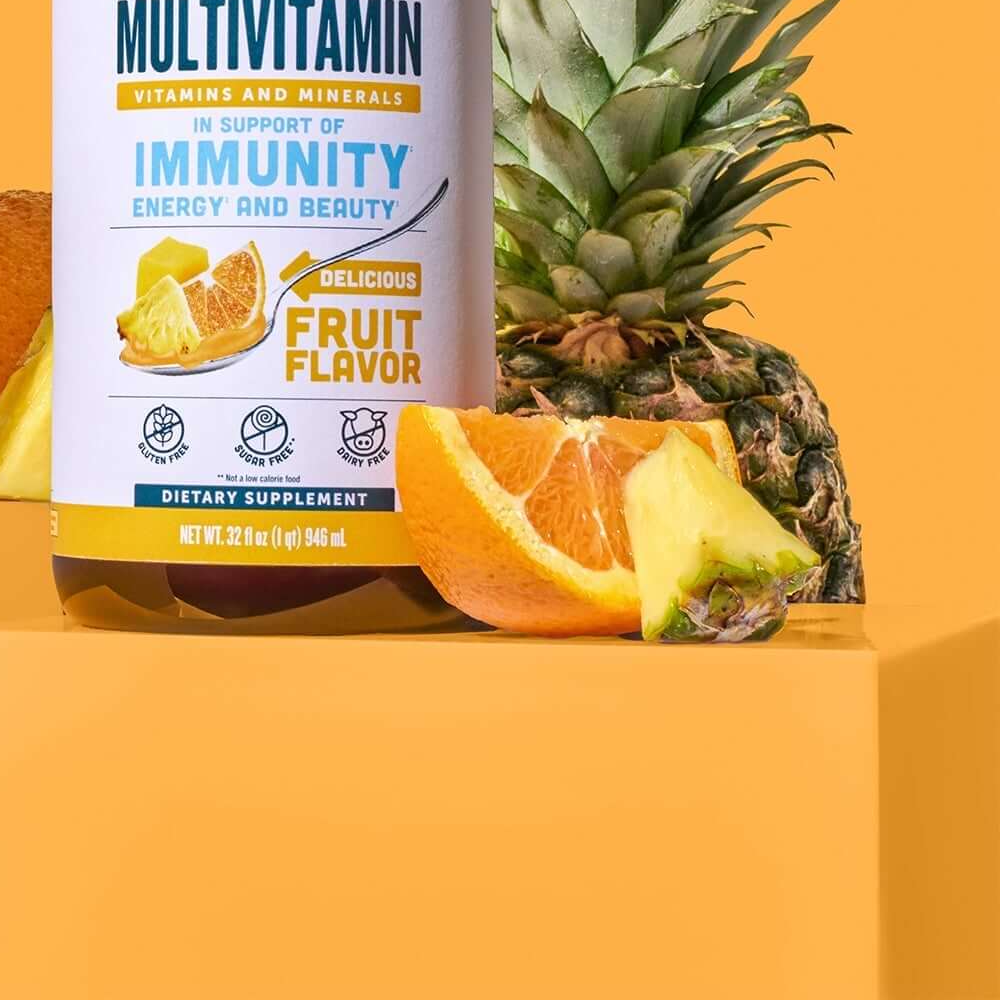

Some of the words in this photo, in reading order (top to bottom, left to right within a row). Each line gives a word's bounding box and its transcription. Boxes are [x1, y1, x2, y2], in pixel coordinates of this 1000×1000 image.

[134, 86, 233, 105] VITAMINS
[242, 86, 288, 103] AND
[298, 87, 403, 107] MINERALS
[193, 117, 212, 133] IN
[220, 116, 313, 134] SUPPORT
[320, 118, 345, 135] OF
[135, 140, 409, 190] IMMUNITY
[132, 196, 226, 218] ENERGY
[236, 196, 288, 218] AND
[299, 197, 396, 220] BEAUTY
[319, 269, 417, 290] DELICIOUS
[286, 307, 422, 350] FRUIT
[286, 350, 421, 385] FLAVOR
[137, 443, 167, 465] GLUTEN
[169, 443, 190, 463] FREE
[234, 445, 265, 467] SUGAR
[336, 447, 364, 468] DAIRY
[367, 448, 391, 467] FREE
[225, 474, 237, 482] Not
[245, 474, 257, 483] low
[259, 475, 283, 483] calorie
[285, 475, 300, 483] food
[161, 489, 238, 505] DIETARY
[244, 491, 368, 507] SUPPLEMENT
[179, 524, 201, 545] NET
[203, 525, 225, 546] WT.
[227, 526, 241, 546] 32
[244, 526, 253, 546] fl
[255, 531, 268, 546] oz
[284, 527, 301, 550] qt)
[305, 527, 328, 547] 946
[330, 529, 347, 547] mL
